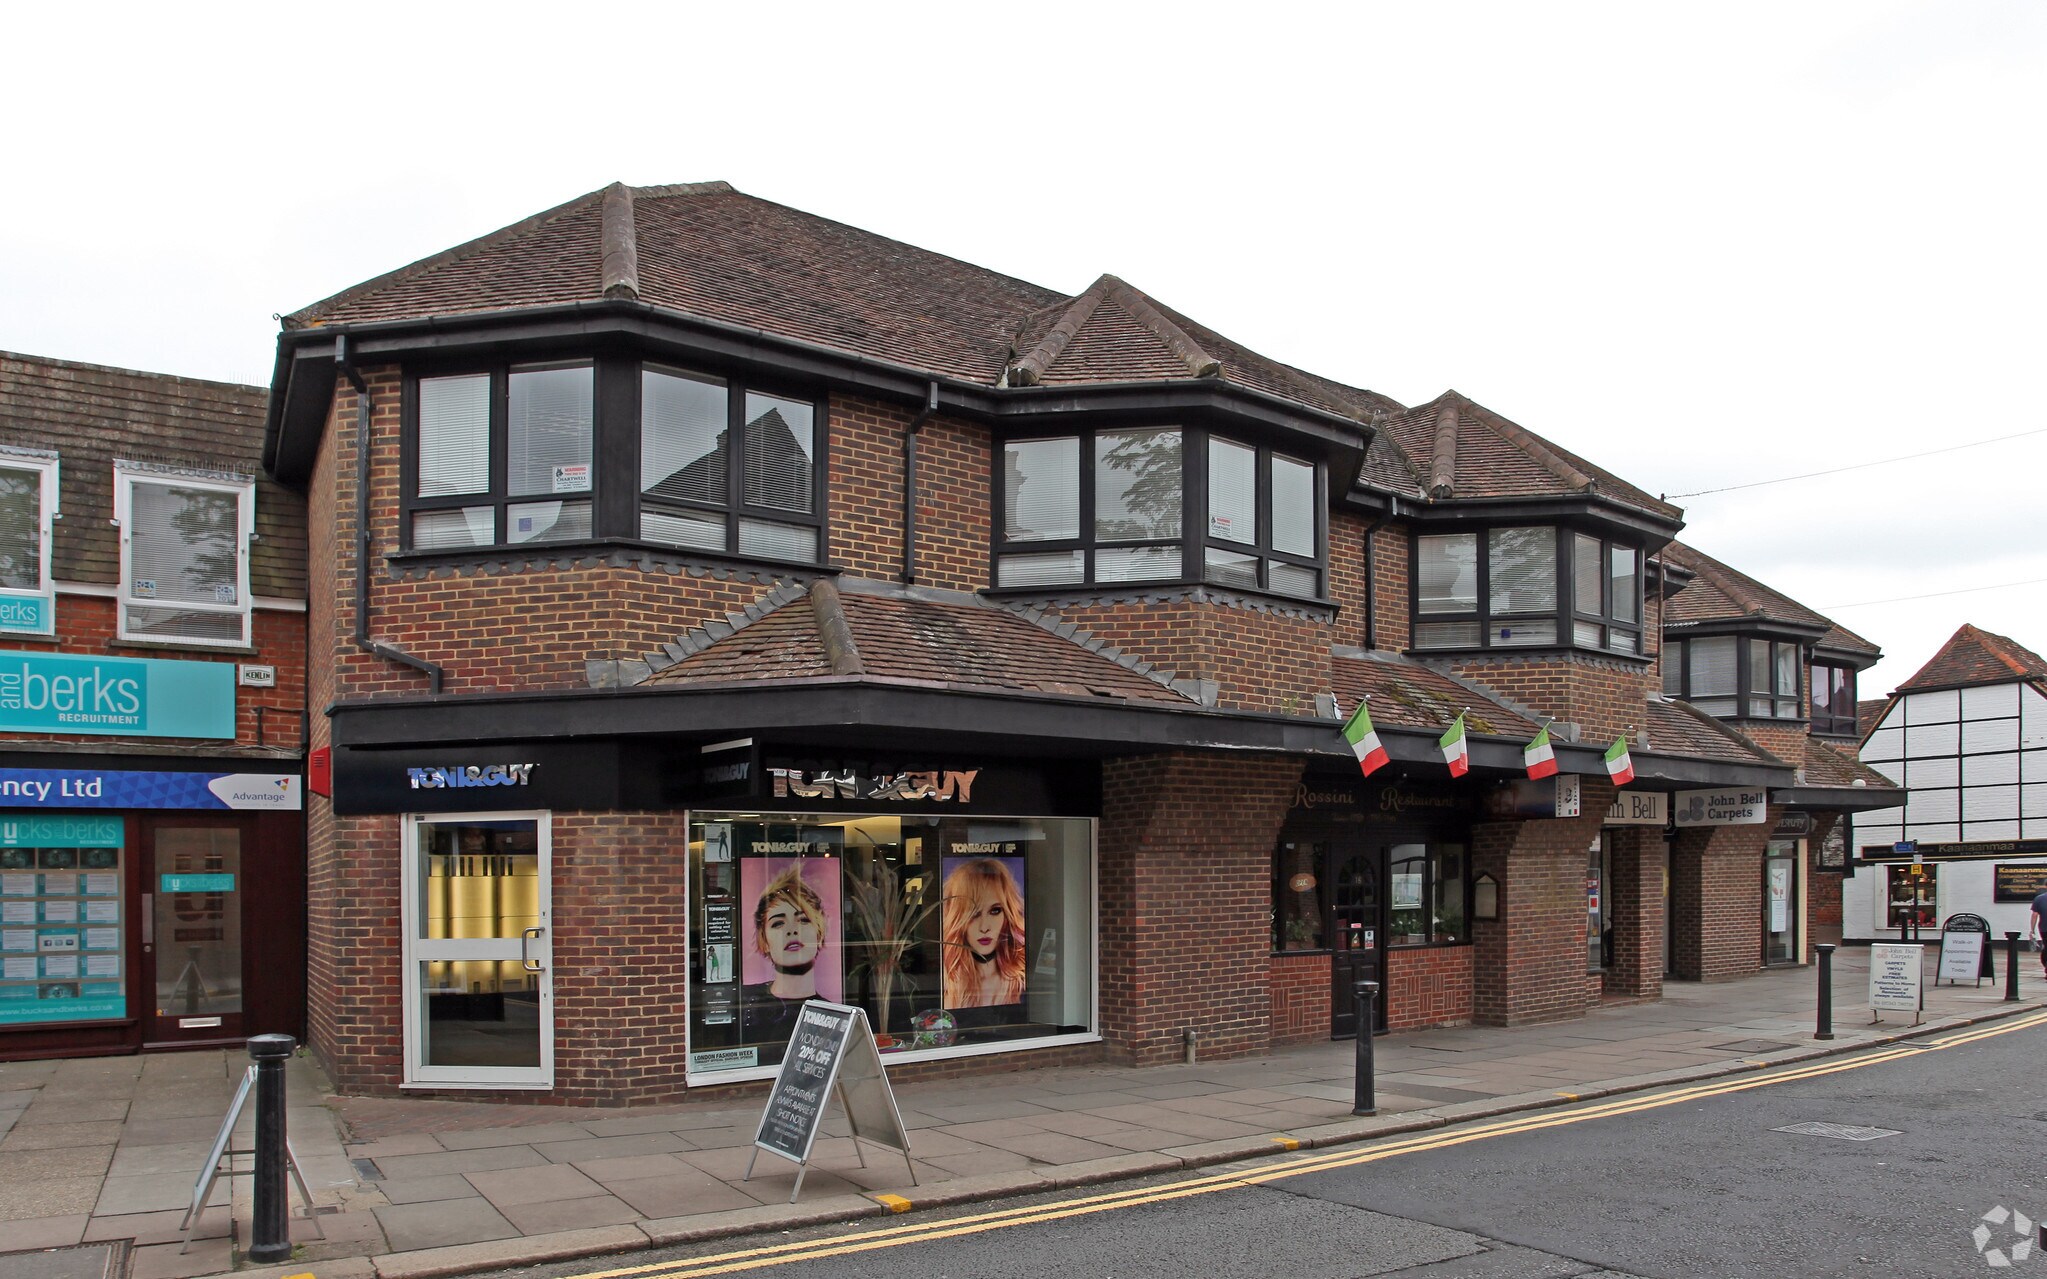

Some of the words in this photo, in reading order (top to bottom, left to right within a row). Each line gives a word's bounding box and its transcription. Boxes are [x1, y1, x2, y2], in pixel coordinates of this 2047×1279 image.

[245, 672, 271, 680] KENLIN
[0, 673, 20, 709] and
[23, 663, 140, 713] berks
[58, 713, 140, 724] RECRUITMENT
[407, 763, 534, 788] TONI&GUY
[0, 781, 51, 801] ncy
[62, 777, 101, 797] Ltd
[232, 792, 285, 802] Advantage
[1289, 783, 1355, 809] Rossini
[1631, 795, 1657, 819] Bell
[1708, 796, 1735, 807] John
[1740, 793, 1763, 804] Bell
[1707, 808, 1753, 821] Carpets
[0, 819, 52, 844] ucks
[63, 819, 116, 840] berks
[751, 841, 811, 853] TONI&GUY
[951, 843, 1000, 853] TONI&GUY
[803, 1010, 840, 1030] TONI&GUY
[798, 1045, 817, 1061] 20%
[815, 1050, 832, 1066] OFF
